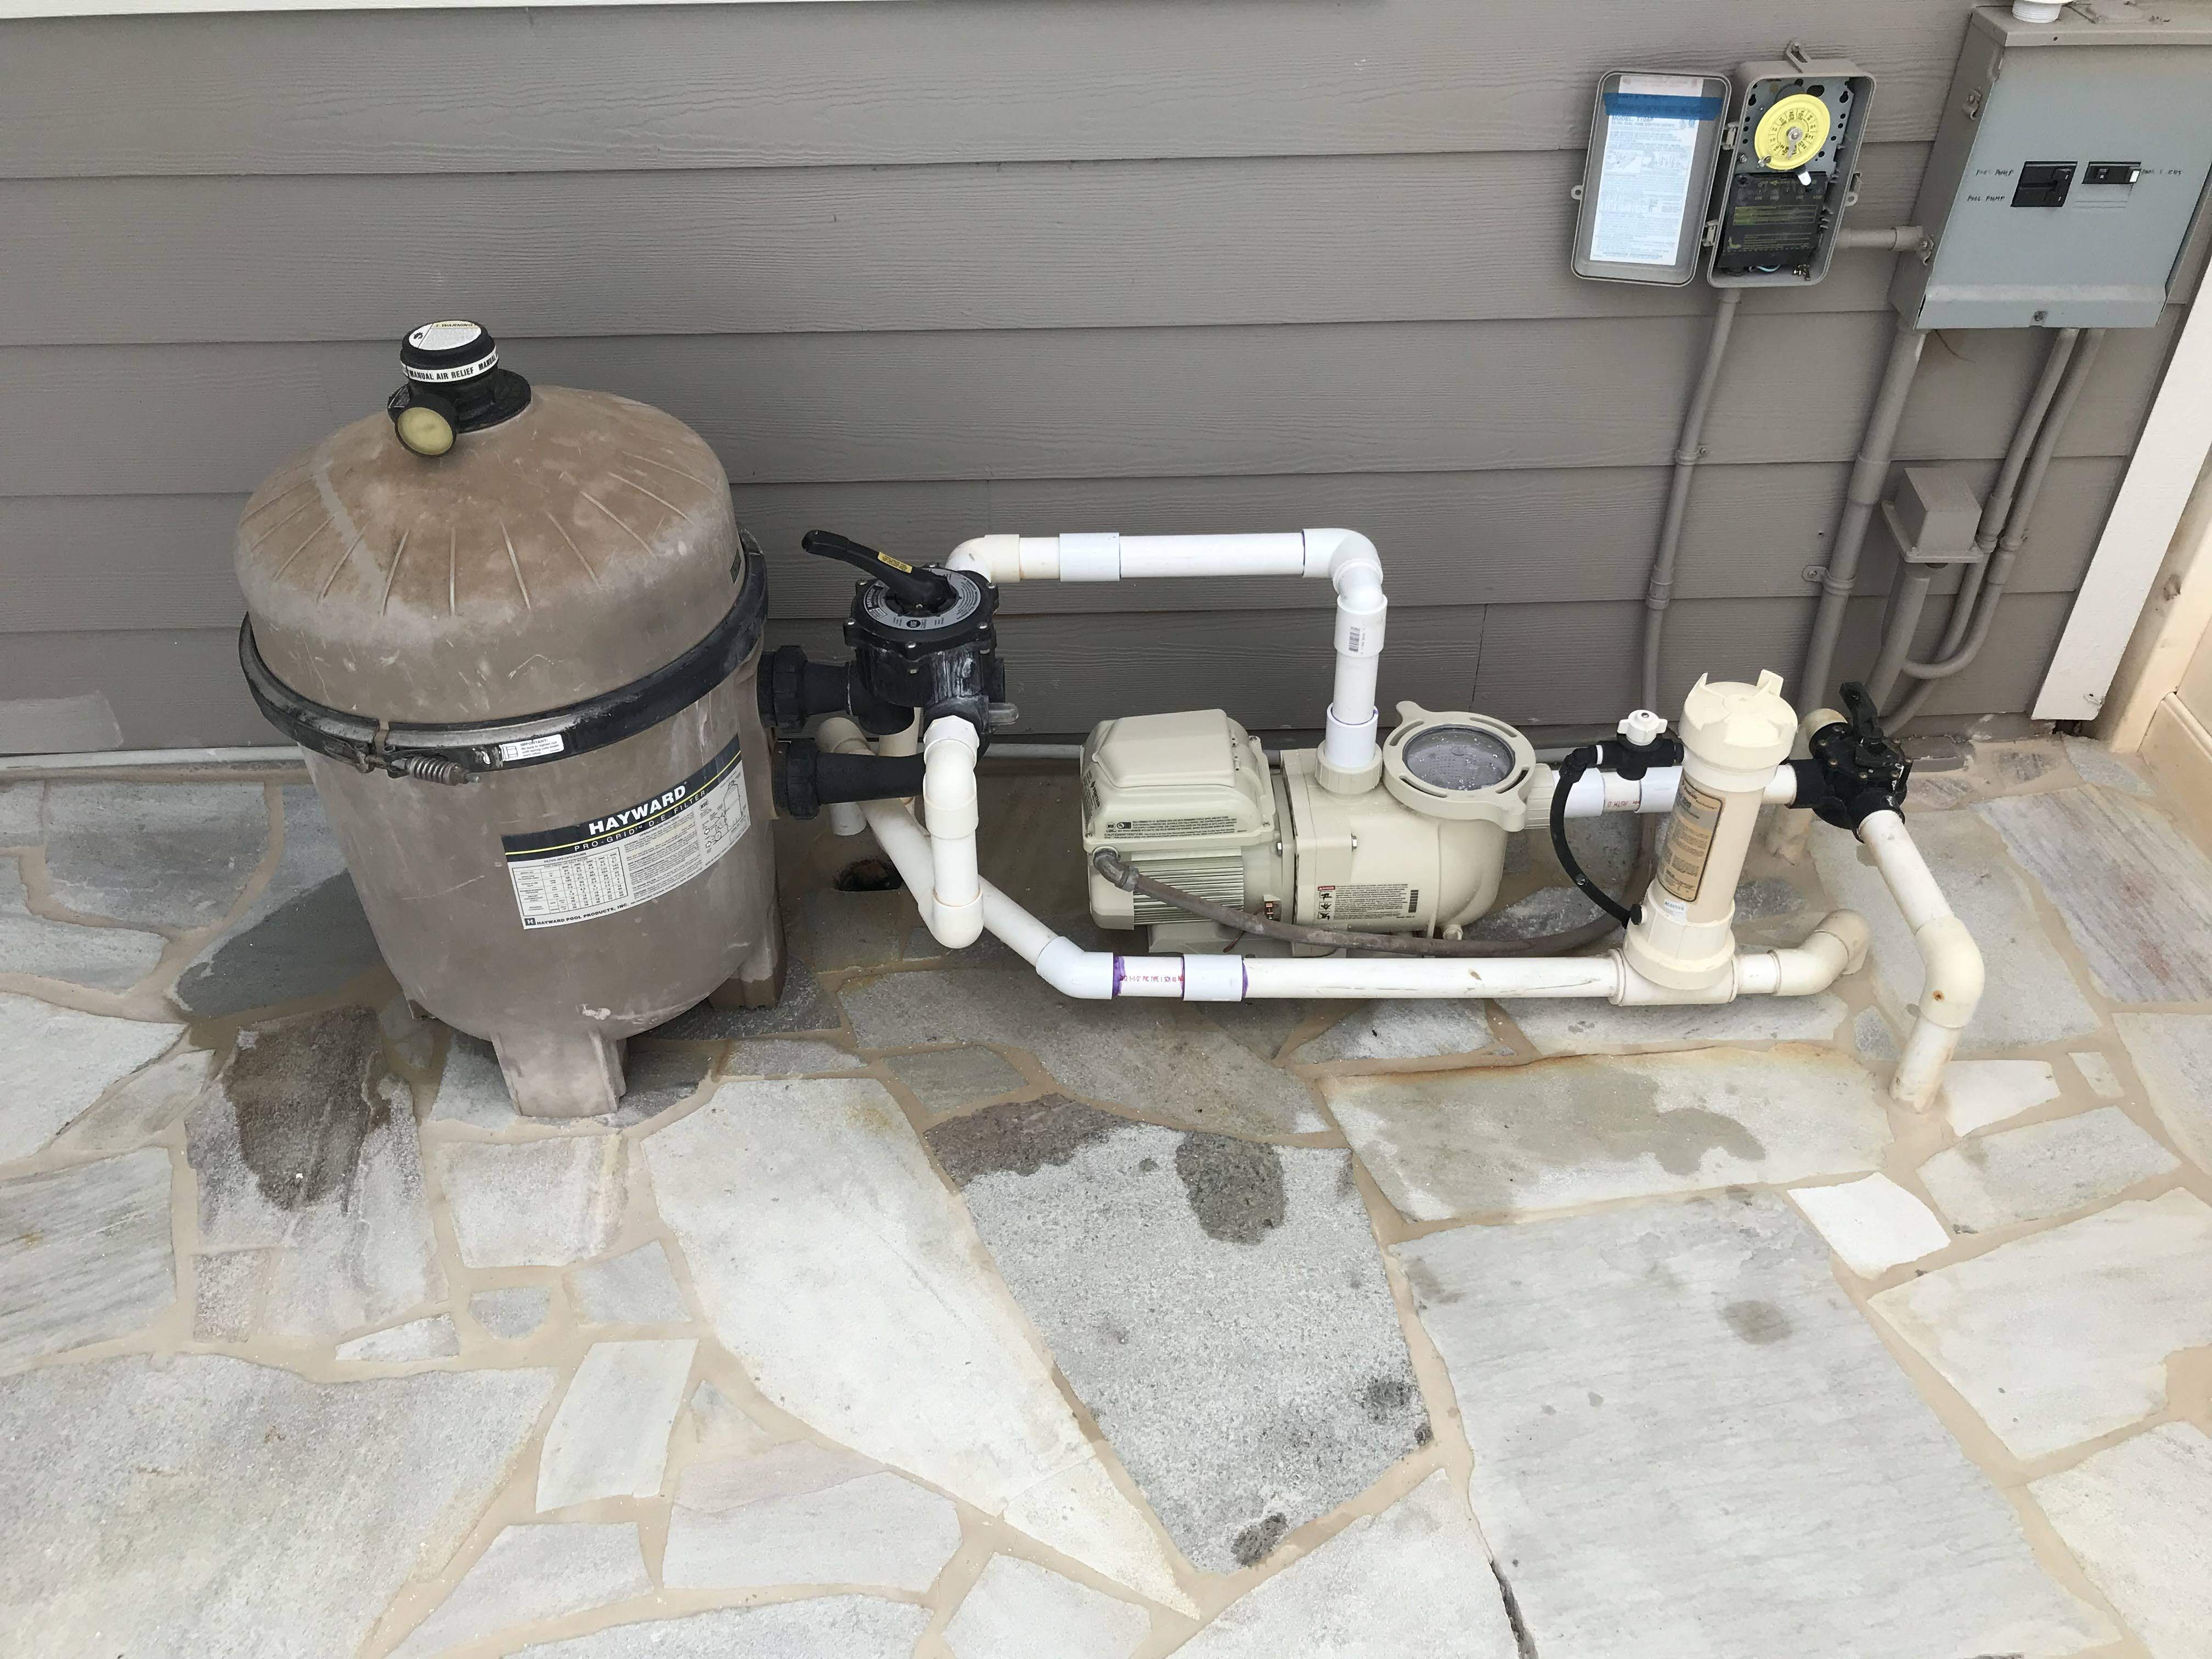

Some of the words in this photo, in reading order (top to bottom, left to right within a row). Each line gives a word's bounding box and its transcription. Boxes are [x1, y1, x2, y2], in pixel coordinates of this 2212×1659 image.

[409, 370, 434, 380] MANUAL
[451, 367, 473, 379] RELIEF
[478, 355, 496, 371] MANUAL
[589, 785, 685, 835] HAYWARD
[674, 790, 706, 815] FILTER
[537, 917, 565, 925] HAYWARD
[566, 913, 582, 921] POOL
[583, 906, 616, 918] PRODUCTS,
